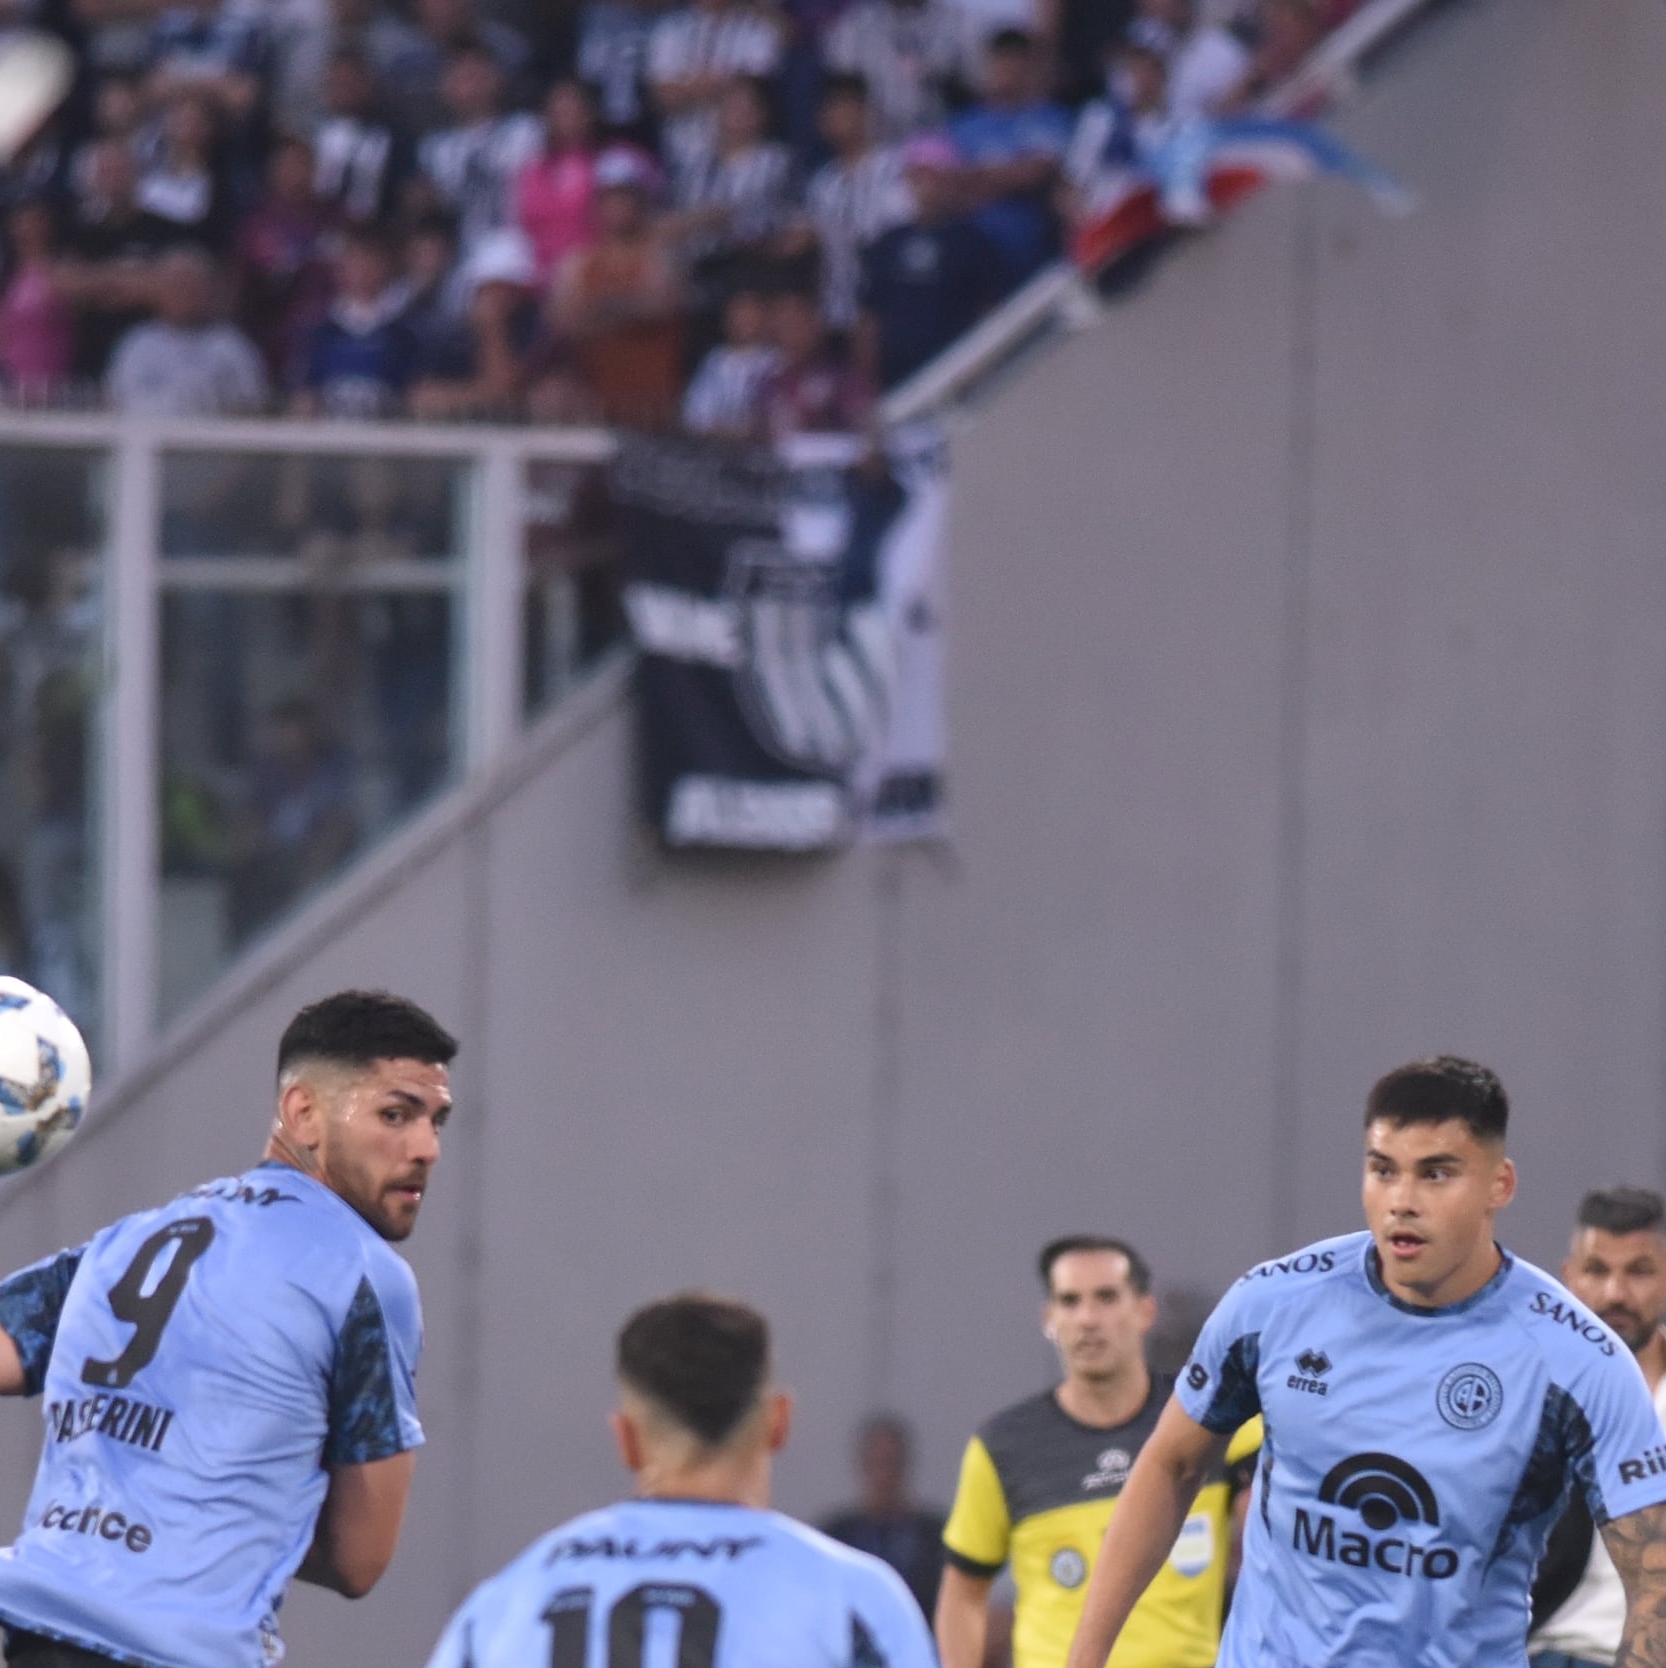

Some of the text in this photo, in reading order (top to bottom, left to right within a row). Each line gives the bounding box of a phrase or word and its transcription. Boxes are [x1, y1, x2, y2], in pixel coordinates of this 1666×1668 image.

[80, 1216, 215, 1388] 9
[1529, 1292, 1617, 1356] SANOS
[1293, 1507, 1459, 1579] Macro
